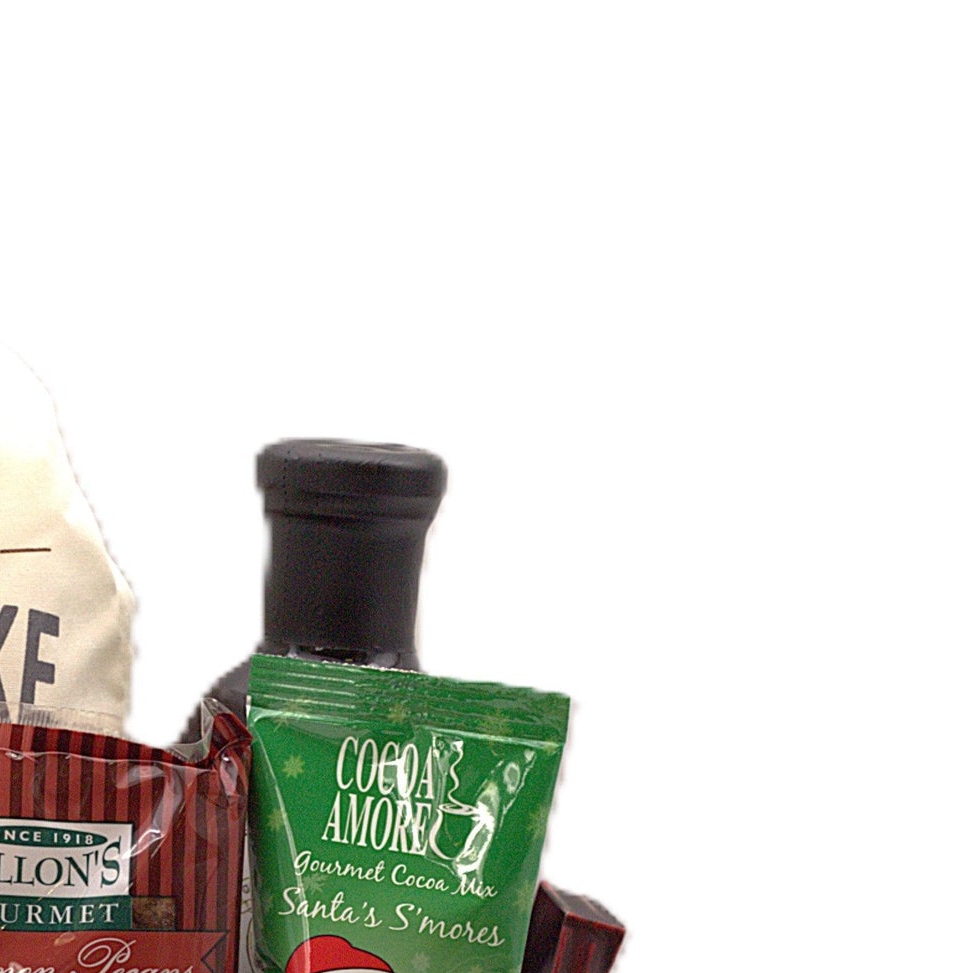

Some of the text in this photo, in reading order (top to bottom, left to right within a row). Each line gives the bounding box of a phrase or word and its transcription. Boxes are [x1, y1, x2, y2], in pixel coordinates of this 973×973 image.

[336, 736, 435, 799] COCOA
[53, 833, 94, 846] 1918
[322, 790, 434, 856] AMORE
[294, 850, 499, 898] Gourmet Cocoa Mix
[278, 887, 382, 928] Santa's
[389, 903, 505, 947] S'mores
